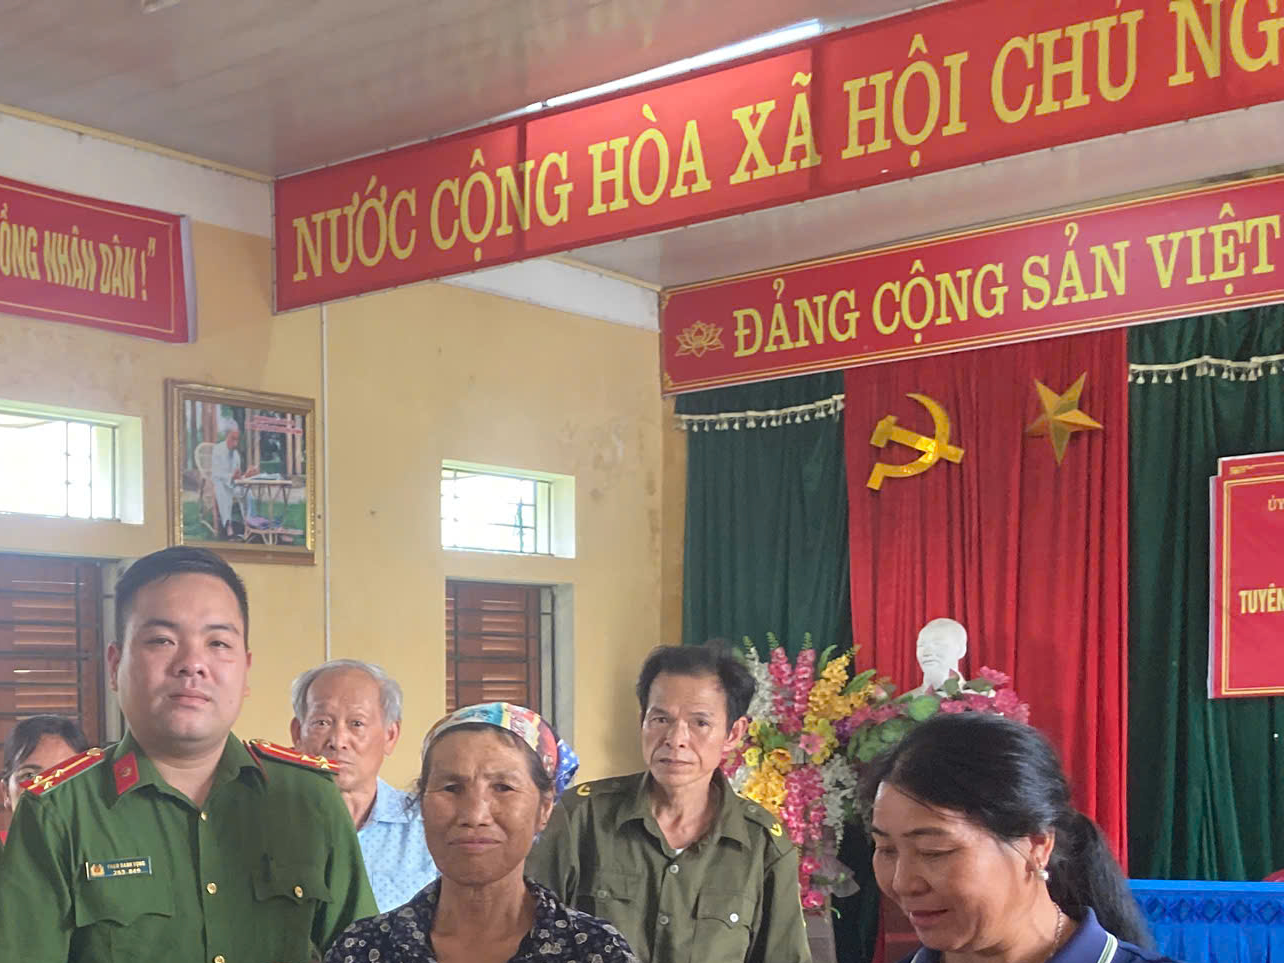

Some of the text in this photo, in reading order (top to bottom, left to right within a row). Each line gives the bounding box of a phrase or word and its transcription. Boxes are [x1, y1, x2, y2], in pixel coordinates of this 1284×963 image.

[293, 176, 417, 281] NƯỚC
[430, 148, 572, 262] CỘNG
[588, 104, 711, 216] HÒA
[730, 72, 820, 185] XÃ
[842, 34, 969, 168] HỘI
[44, 225, 96, 292] NHÂN
[100, 234, 136, 300] DÂN
[733, 202, 1283, 359] ĐẢNG CỘNG SẢN VIỆT
